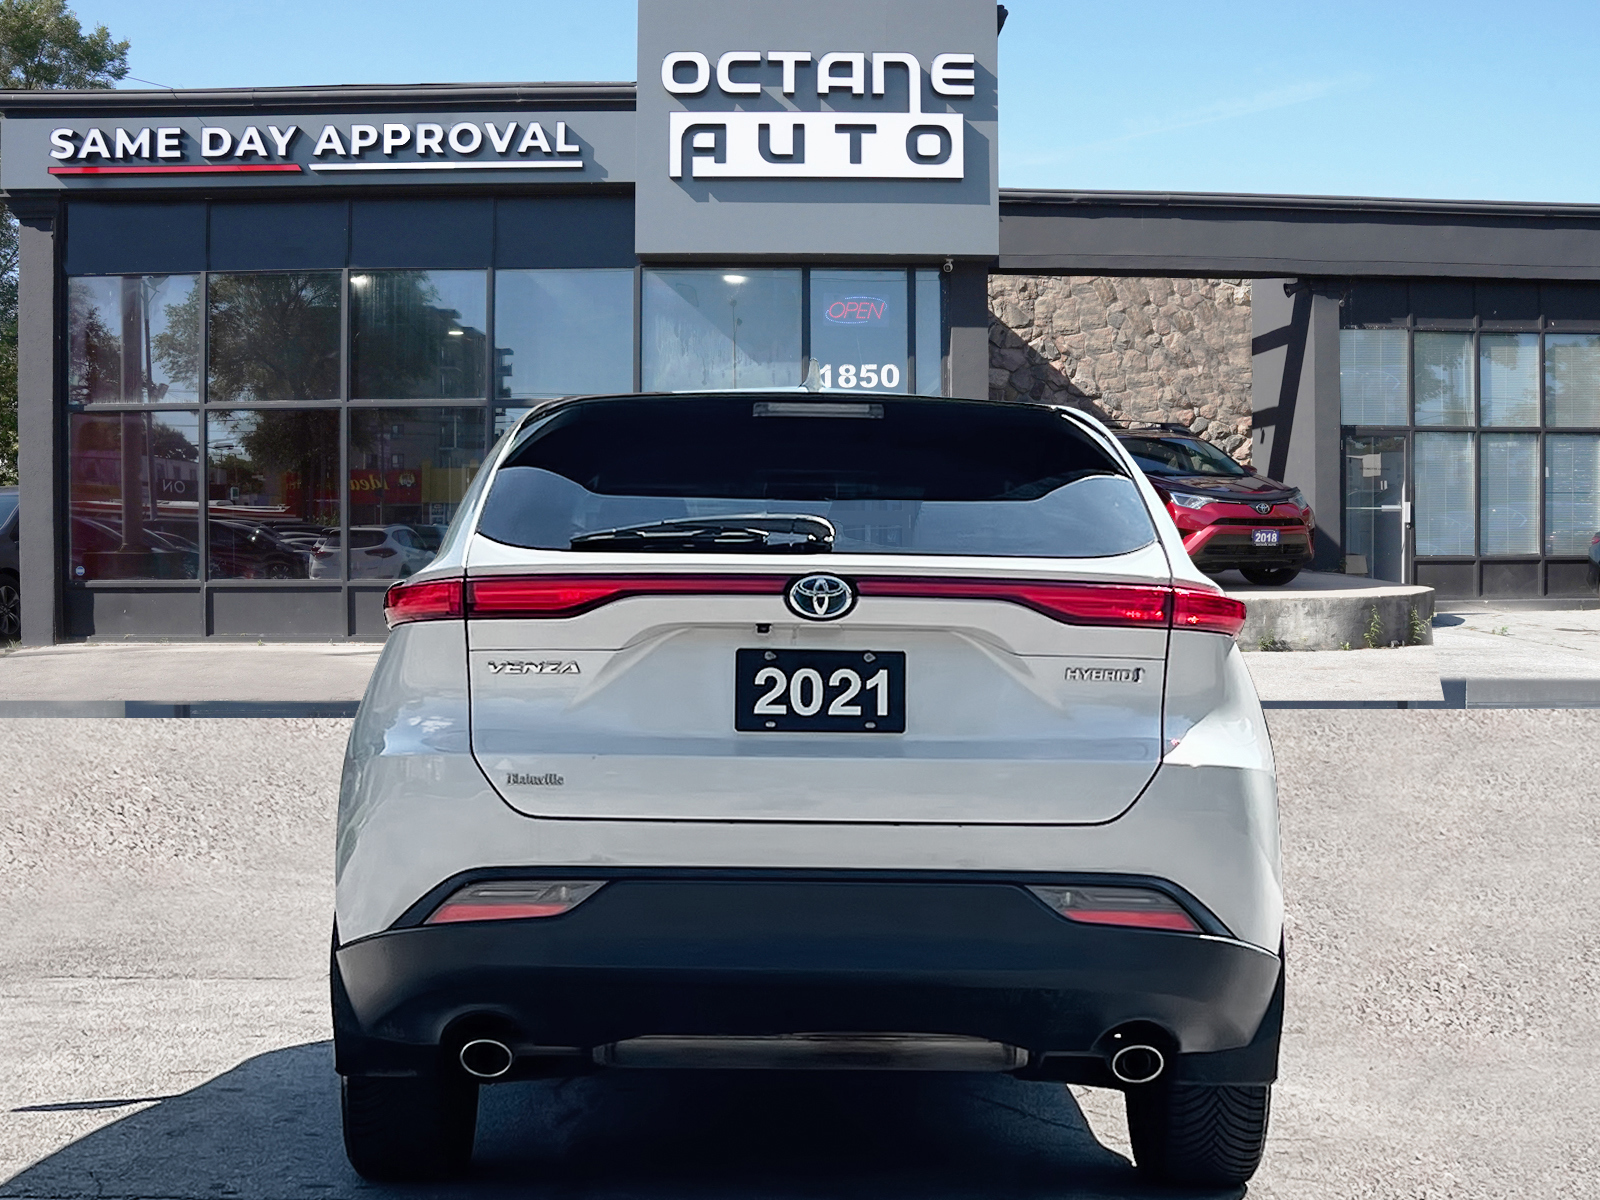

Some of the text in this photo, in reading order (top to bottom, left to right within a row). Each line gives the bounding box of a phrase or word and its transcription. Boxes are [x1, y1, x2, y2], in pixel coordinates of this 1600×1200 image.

[661, 51, 975, 112] OCTANE
[49, 121, 581, 160] SAME DAY APPROVAL
[680, 122, 953, 178] AUTO
[829, 301, 885, 319] OPEN
[819, 363, 900, 388] 1850
[1255, 532, 1278, 543] 2018
[487, 660, 581, 675] VENZA
[1065, 666, 1133, 682] HYBRID
[753, 666, 889, 717] 2021
